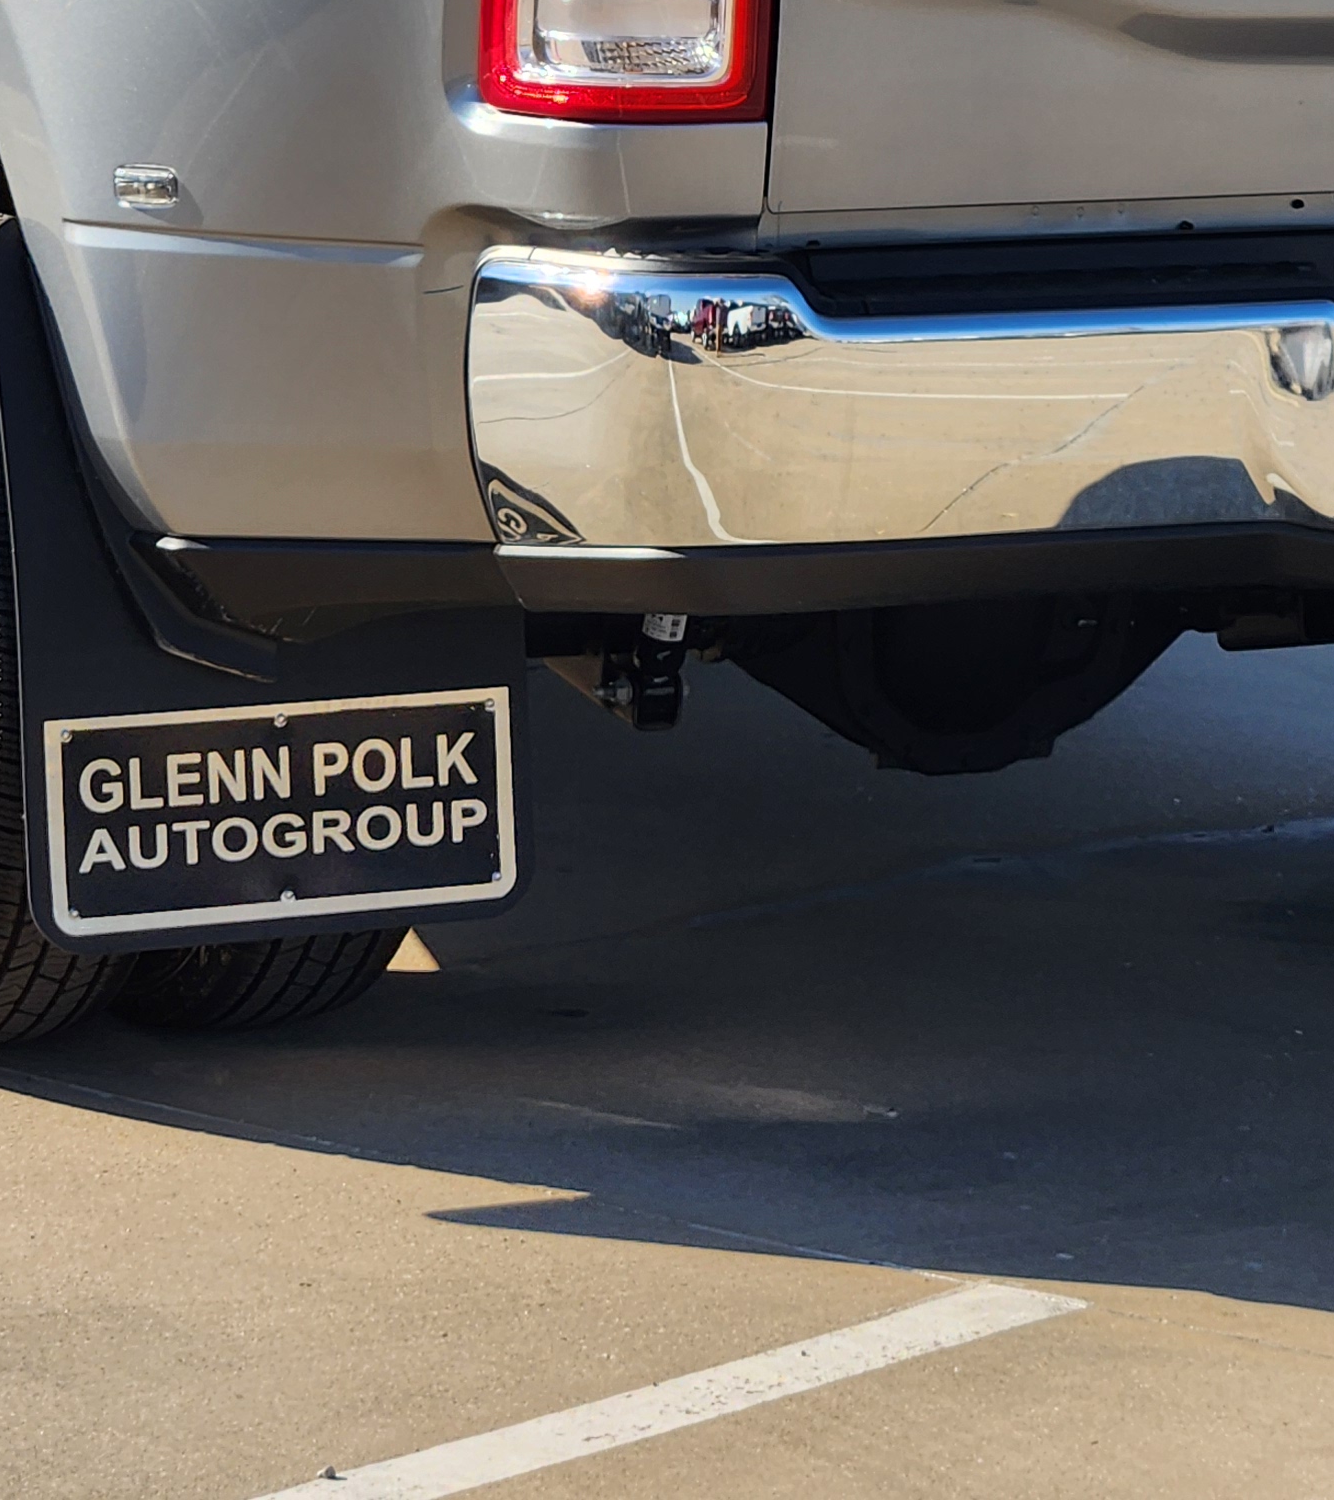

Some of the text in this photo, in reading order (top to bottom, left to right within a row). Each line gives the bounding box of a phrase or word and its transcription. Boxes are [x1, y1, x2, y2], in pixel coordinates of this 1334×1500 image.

[78, 732, 478, 814] GLENN POLK
[78, 798, 488, 875] AUTOGROUP
